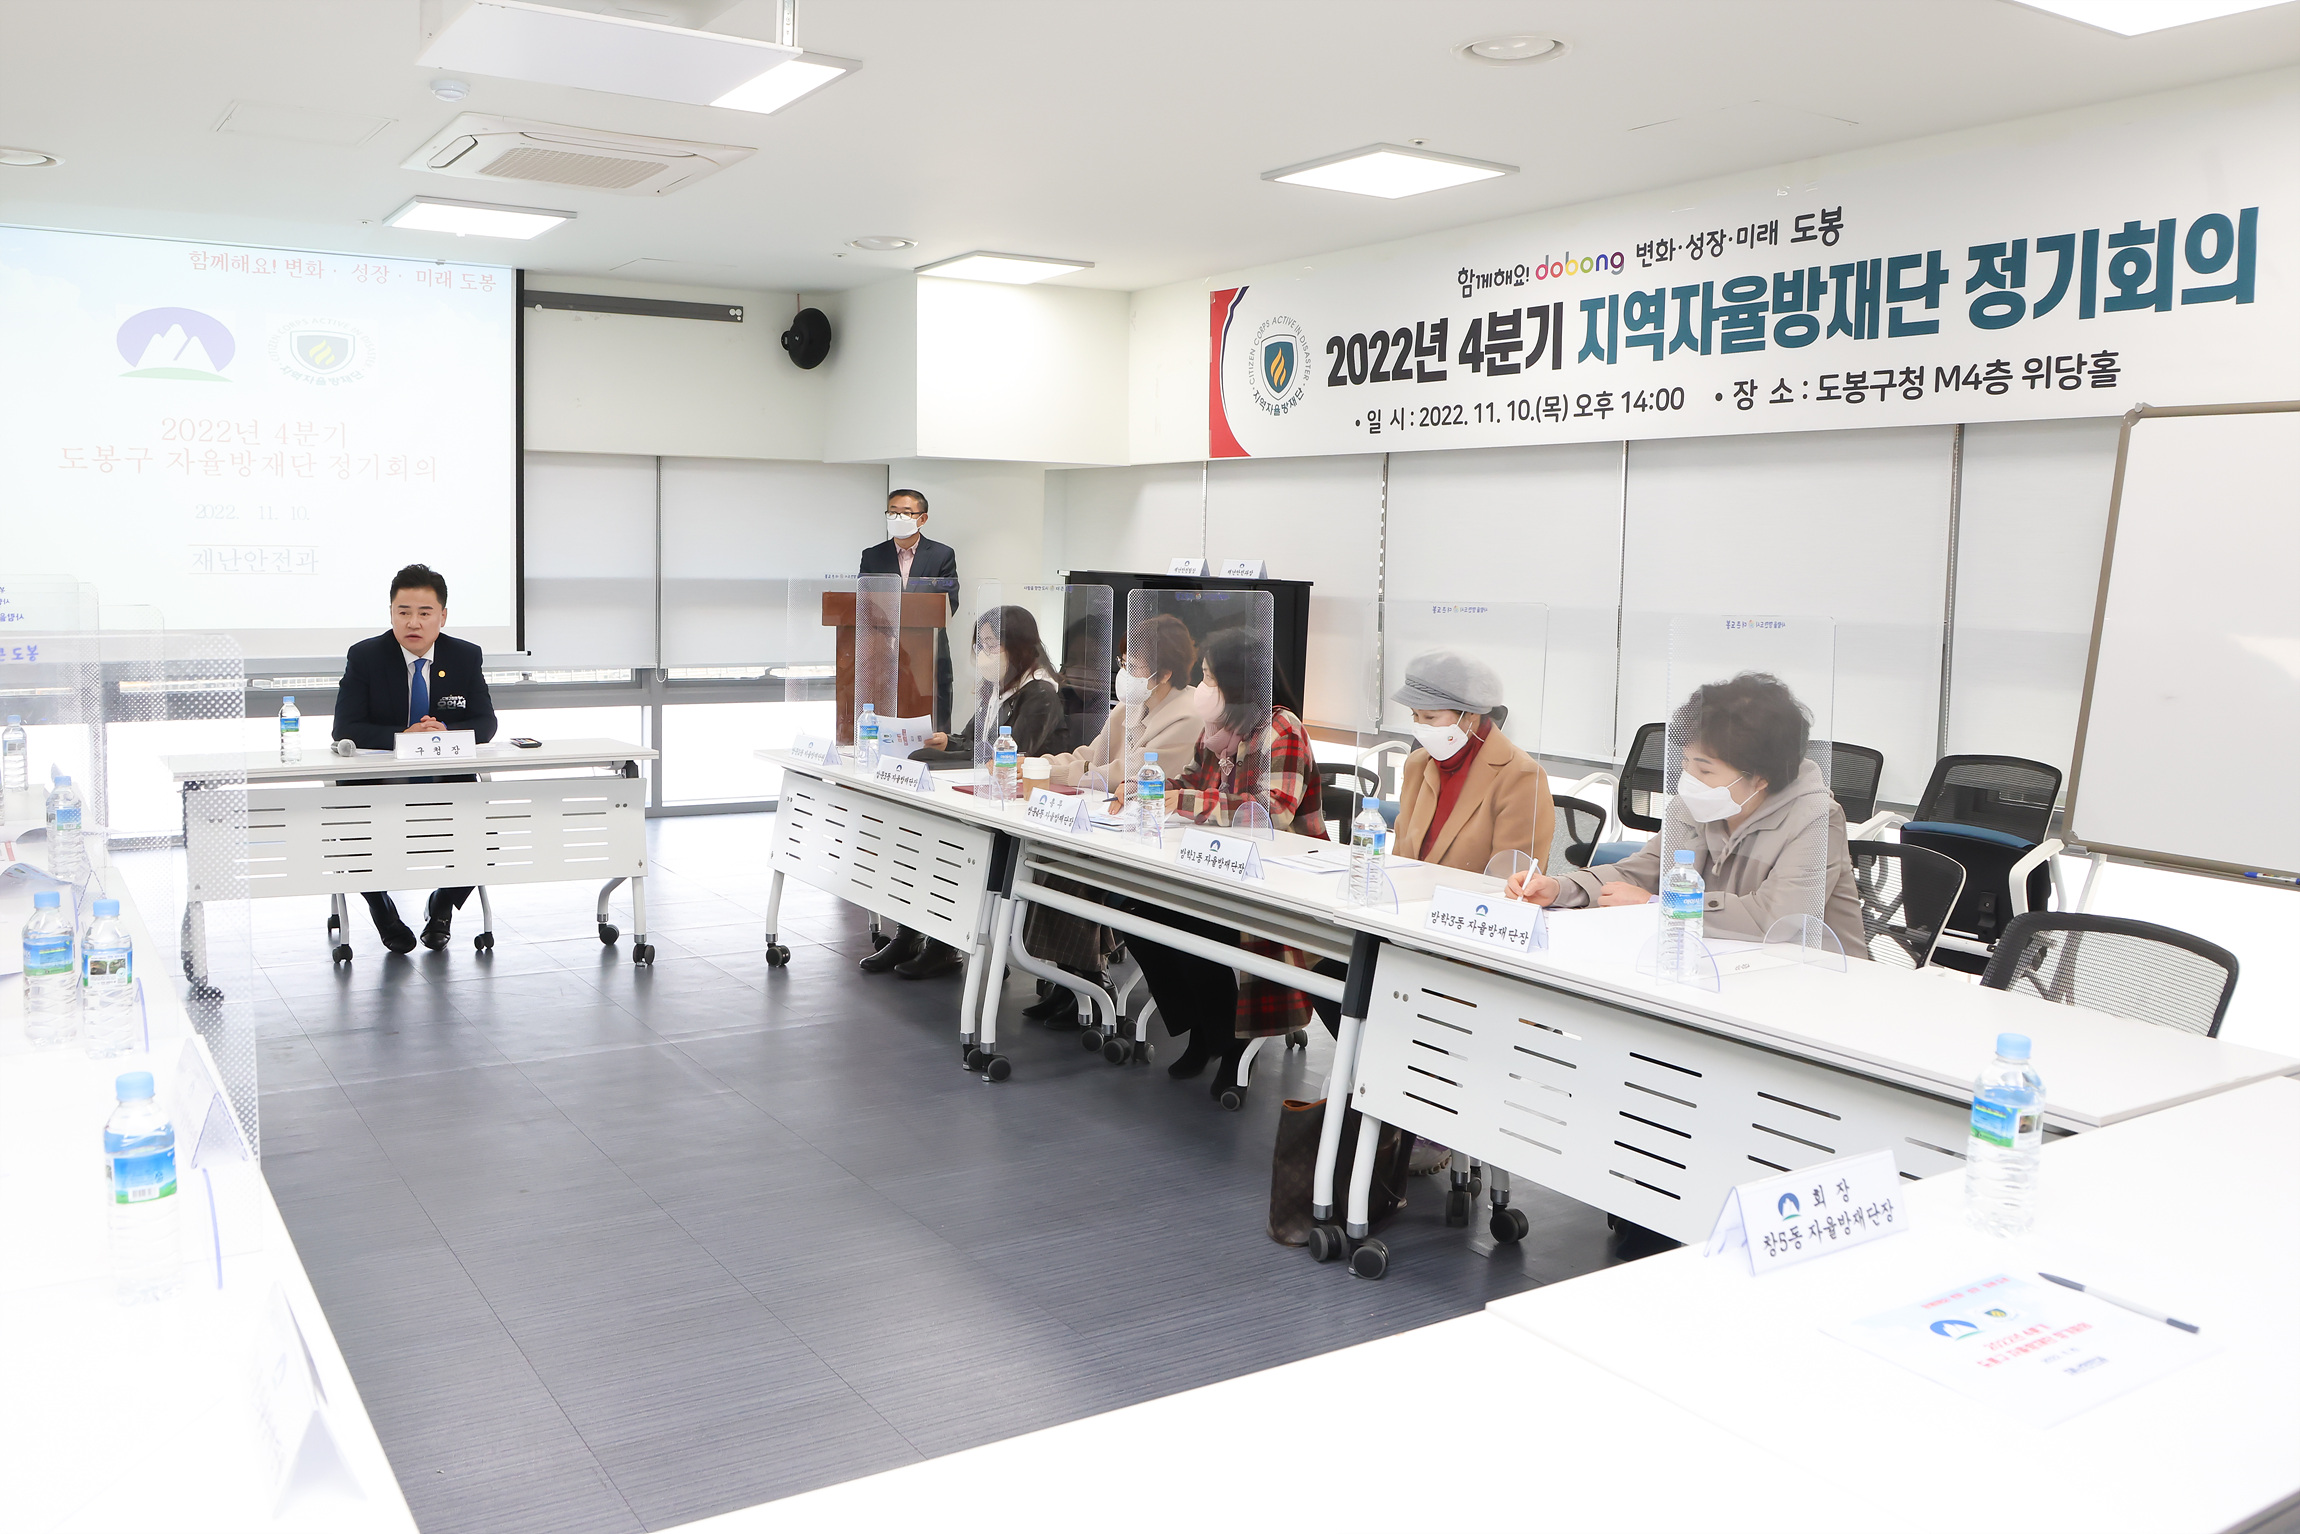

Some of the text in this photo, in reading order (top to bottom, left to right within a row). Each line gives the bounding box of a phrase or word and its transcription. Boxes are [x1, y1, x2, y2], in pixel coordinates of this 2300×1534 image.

[189, 250, 497, 293] 함께해요! 변화 성장 미래 도봉
[1457, 265, 1530, 298] 함께해요!
[1534, 250, 1626, 281] dobong
[1790, 206, 1844, 246] 도봉
[1326, 206, 2260, 387] 2022년 4분기 지역자율방재단 정기회의
[1733, 380, 1757, 410] 장
[1816, 366, 1925, 403] 도봉구청
[1934, 360, 2013, 395] M4층
[2022, 351, 2121, 390] 위당홀
[1367, 410, 1382, 434] 일
[1419, 405, 1468, 427] 2022.
[1475, 404, 1501, 424] 11.
[1574, 392, 1614, 420] 오후
[1621, 387, 1685, 412] 14:00
[161, 416, 348, 449] 2022년 4분기
[58, 444, 438, 483] 도봉구 자율방재단 정기회의
[191, 547, 319, 574] 재난안전과
[11, 644, 39, 662] 도봉
[1204, 854, 1244, 875] 자율방재단장
[1431, 911, 1529, 945] 방학3동 자율방재단장
[1812, 1178, 1850, 1208] 회 장
[1763, 1198, 1894, 1257] 창5동 자율방재단장
